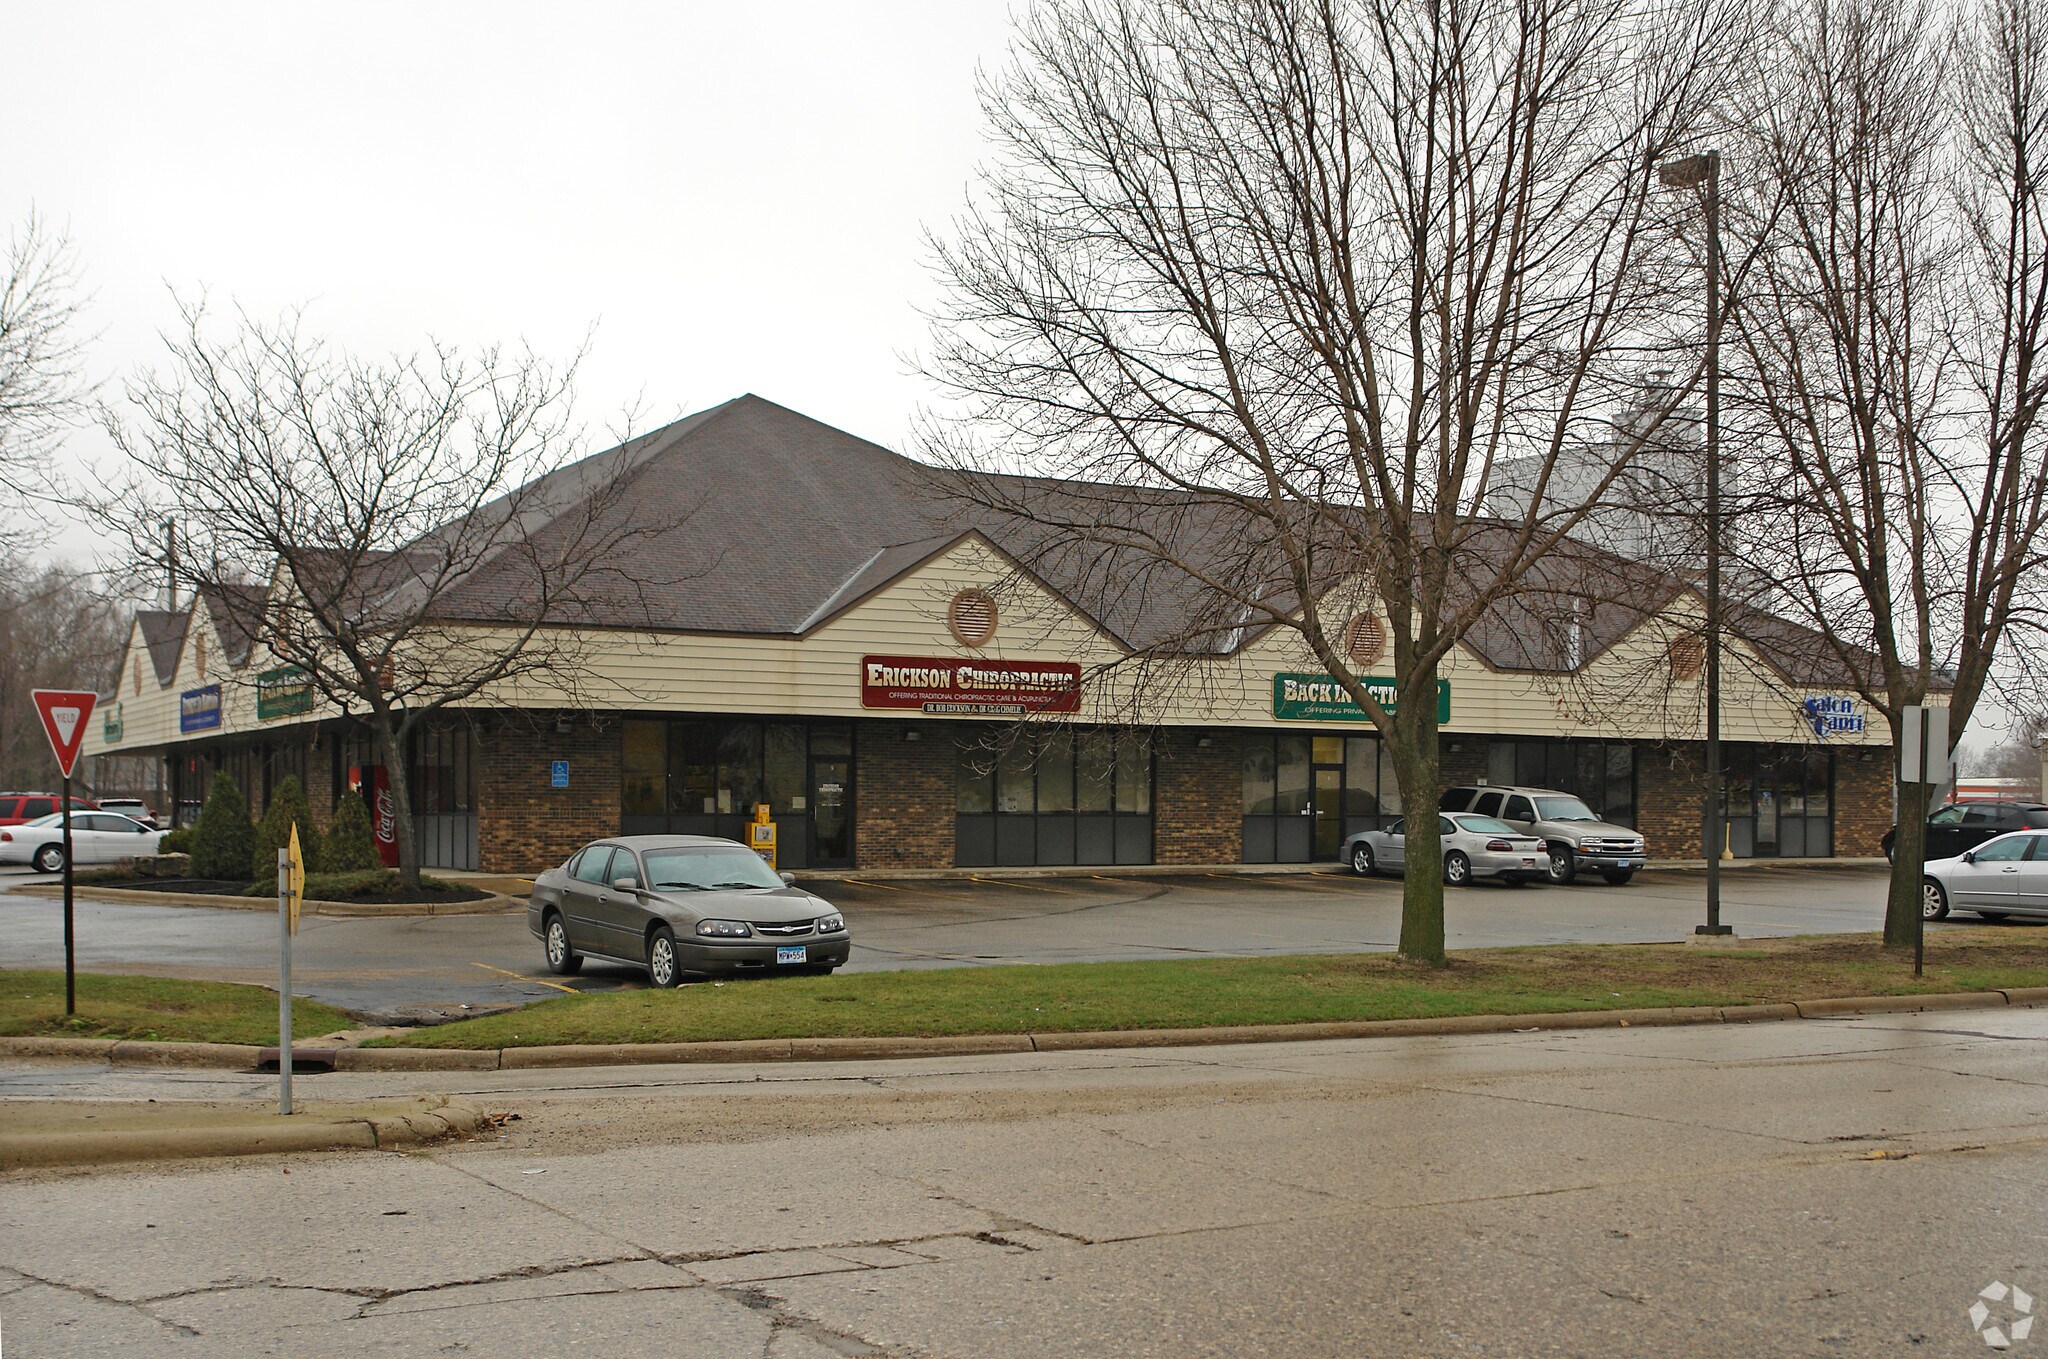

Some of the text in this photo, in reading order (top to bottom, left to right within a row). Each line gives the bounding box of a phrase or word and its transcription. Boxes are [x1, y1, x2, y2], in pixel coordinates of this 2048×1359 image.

[867, 663, 1073, 692] ERICKSON CHIROPRACTIC
[888, 691, 918, 699] OFFERING
[919, 692, 953, 700] TRADITIONAL
[953, 693, 995, 701] CHIROPRACTIC
[1284, 679, 1331, 703] BACK
[1334, 684, 1352, 704] IN
[1305, 706, 1341, 714] OFFERING
[56, 712, 76, 724] YIELD
